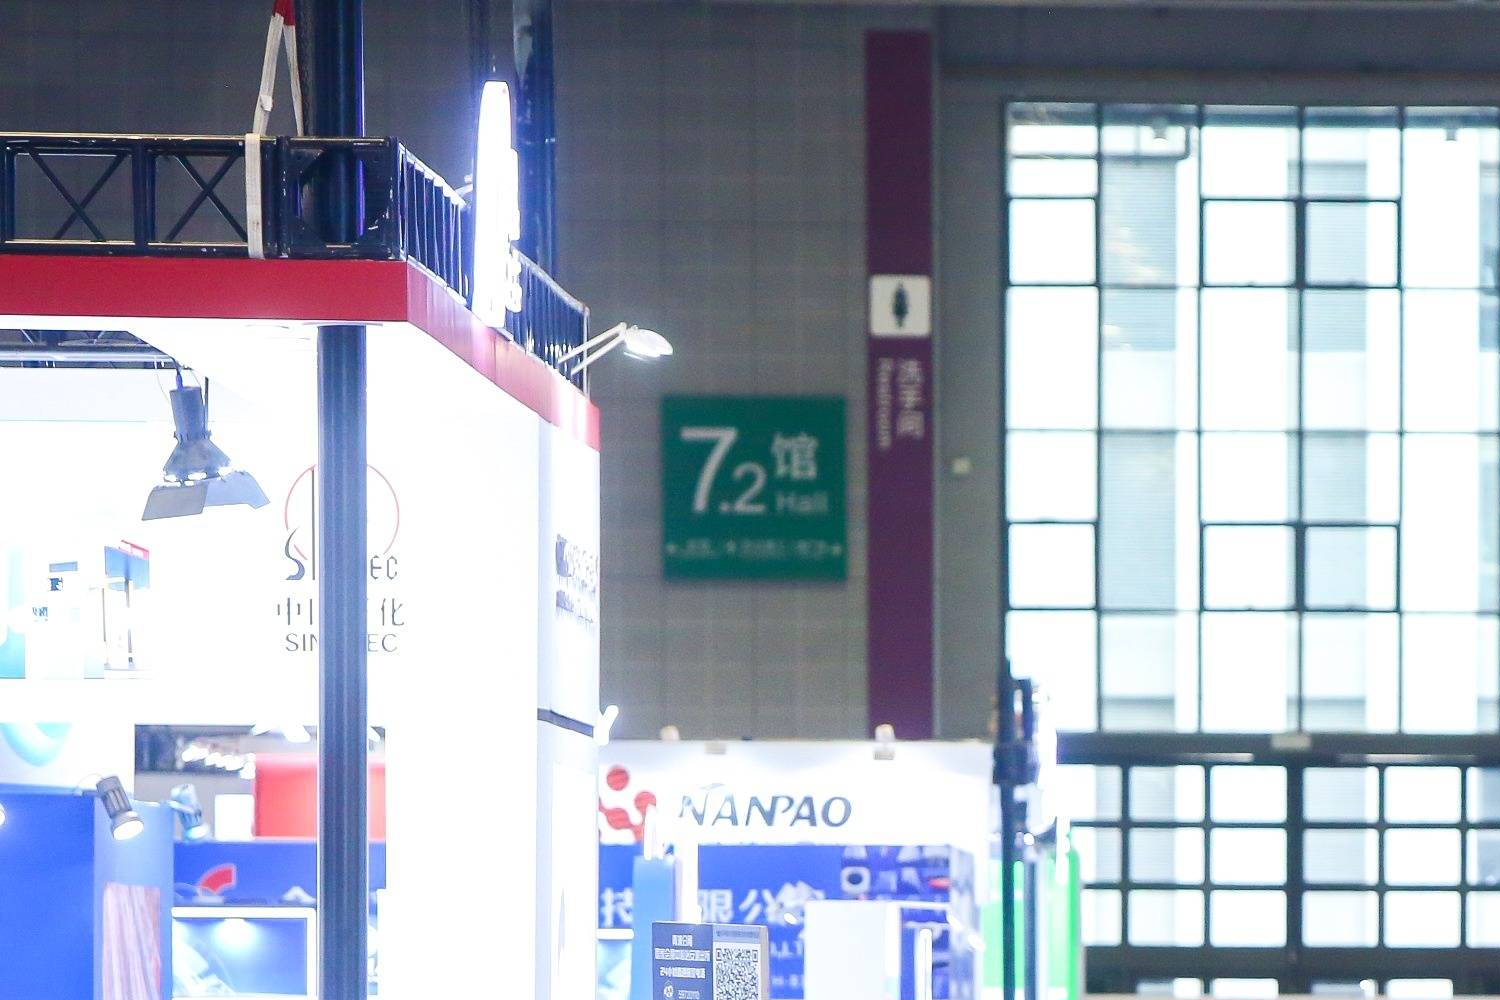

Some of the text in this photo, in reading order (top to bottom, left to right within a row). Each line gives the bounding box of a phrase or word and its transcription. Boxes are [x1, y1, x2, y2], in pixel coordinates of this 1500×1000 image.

[680, 427, 767, 513] 7.2
[771, 431, 819, 480] 馆
[277, 598, 405, 626] 中化
[678, 784, 852, 828] NANPAO
